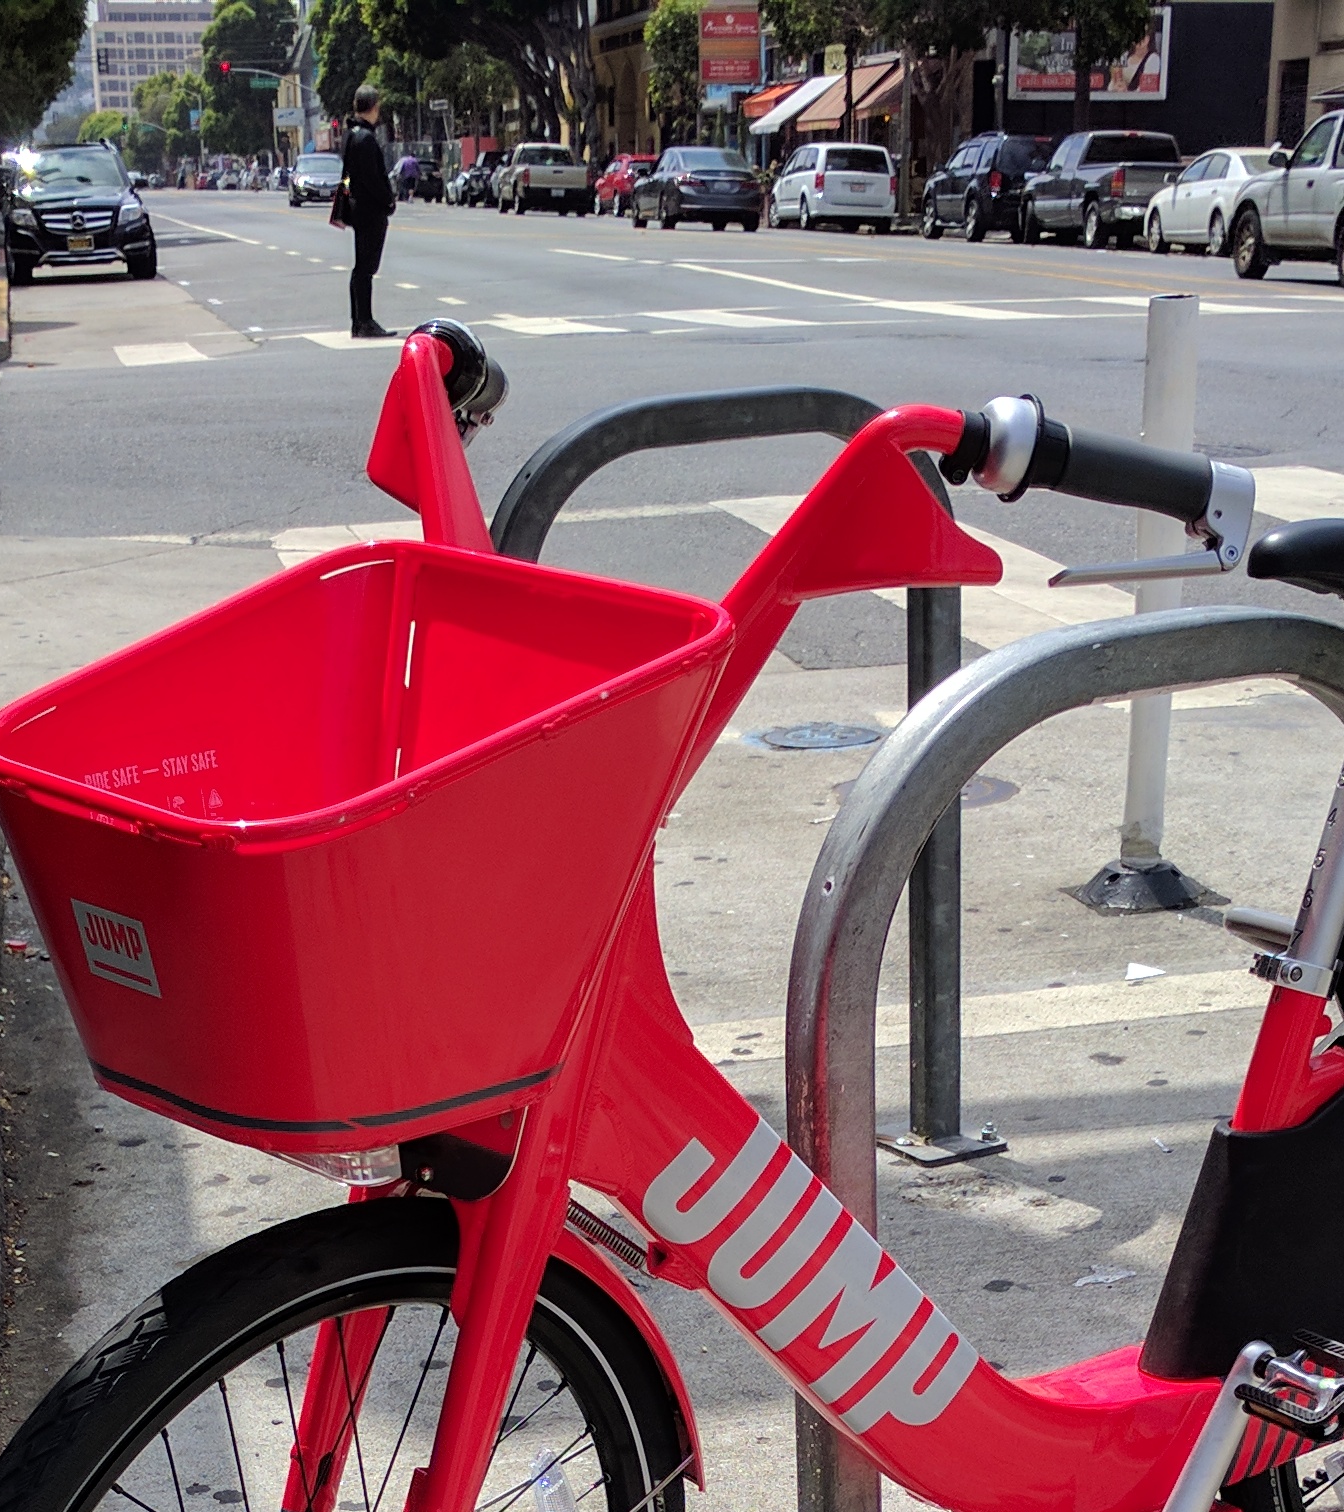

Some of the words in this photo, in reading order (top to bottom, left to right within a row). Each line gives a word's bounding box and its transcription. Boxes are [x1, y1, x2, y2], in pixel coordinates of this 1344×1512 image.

[84, 770, 111, 789] RIDE
[112, 765, 140, 788] SAFE
[162, 755, 188, 778] STAY
[190, 750, 219, 772] SAFE
[1327, 808, 1338, 828] 4
[1313, 848, 1327, 869] 5
[1302, 888, 1314, 910] 6
[83, 912, 144, 962] JUMP
[1291, 928, 1303, 948] 7
[642, 1116, 980, 1435] JUMP
